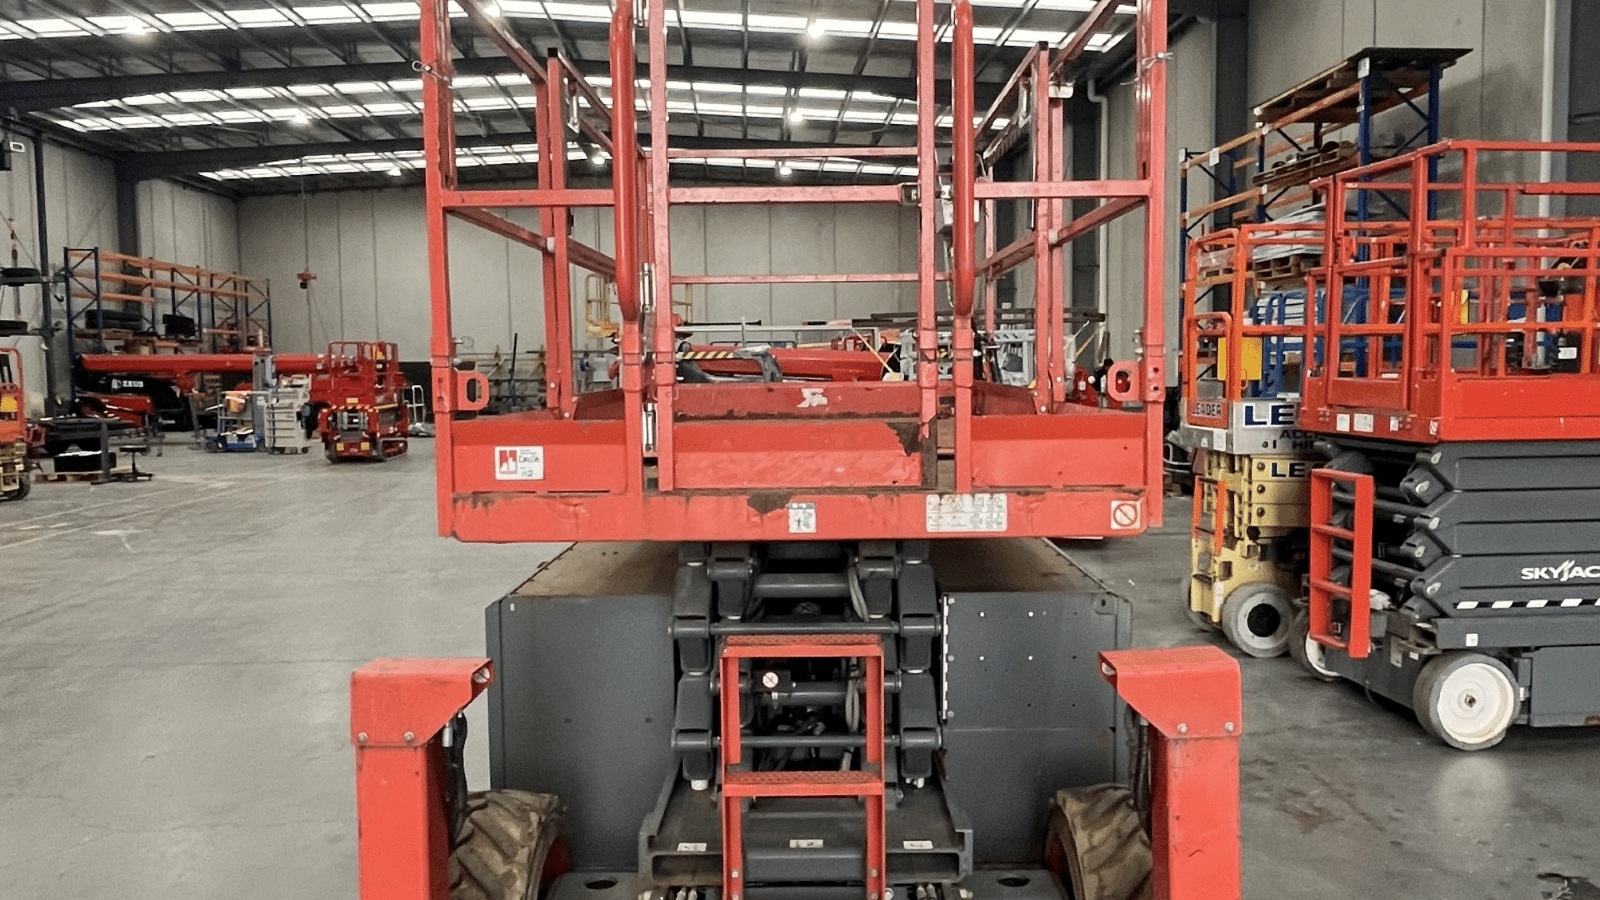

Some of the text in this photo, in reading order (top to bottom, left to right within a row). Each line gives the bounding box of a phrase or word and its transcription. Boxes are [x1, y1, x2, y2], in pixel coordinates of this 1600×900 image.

[1192, 402, 1221, 416] LEADER
[1280, 429, 1317, 439] ACC
[1271, 462, 1324, 477] LE
